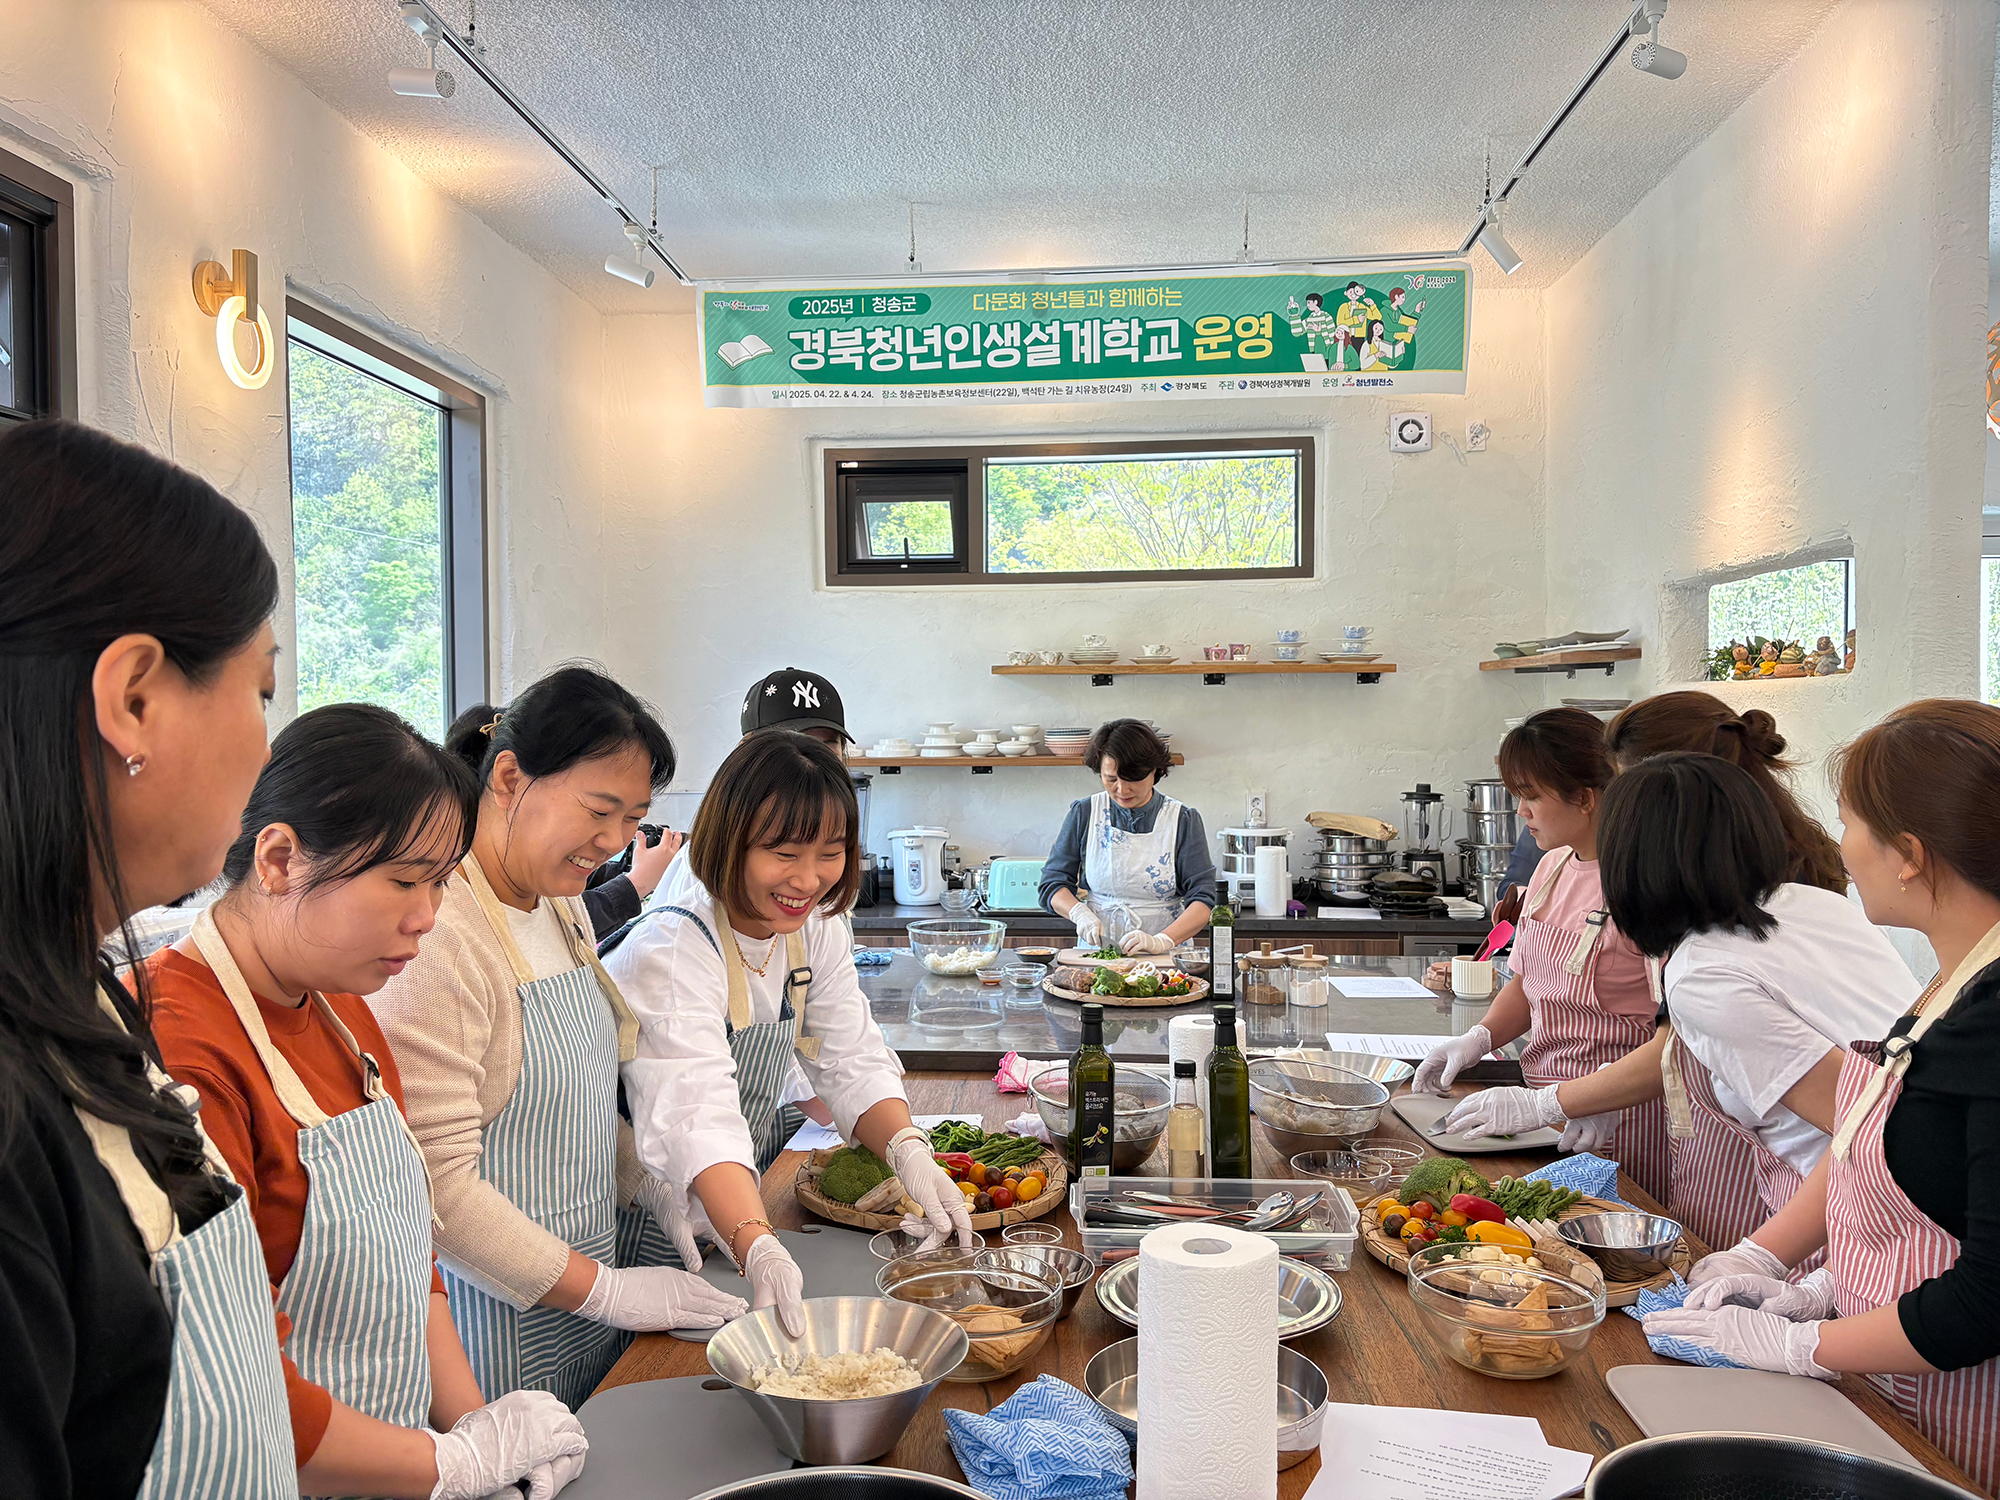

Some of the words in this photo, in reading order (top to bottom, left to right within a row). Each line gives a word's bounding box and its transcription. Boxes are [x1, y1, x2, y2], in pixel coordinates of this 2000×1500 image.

[802, 298, 854, 316] 2025년
[871, 296, 917, 313] 청송군
[973, 292, 1027, 312] 다문화
[1031, 290, 1105, 310] 청년들과
[1108, 286, 1183, 308] 함께하는
[789, 317, 1182, 372] 경북청년인생설계학교
[1193, 312, 1274, 361] 운영
[1141, 382, 1157, 392] 주최
[1175, 381, 1207, 391] 경상북도
[1218, 380, 1235, 390] 주관
[1322, 377, 1338, 387] 운영
[1356, 378, 1394, 387] 청년발전소
[772, 391, 788, 399] 일시
[789, 391, 812, 399] 2025.
[813, 391, 827, 399] 04.
[829, 390, 842, 398] 22.
[843, 390, 850, 398] &
[851, 390, 859, 398] 4.
[861, 390, 874, 398] 24.
[882, 390, 898, 399] 장소
[1021, 386, 1045, 396] 백석탄
[1047, 386, 1063, 396] 가는
[1065, 385, 1073, 395] 길
[1075, 383, 1132, 395] 치유농장(24일)
[791, 680, 821, 708] NY
